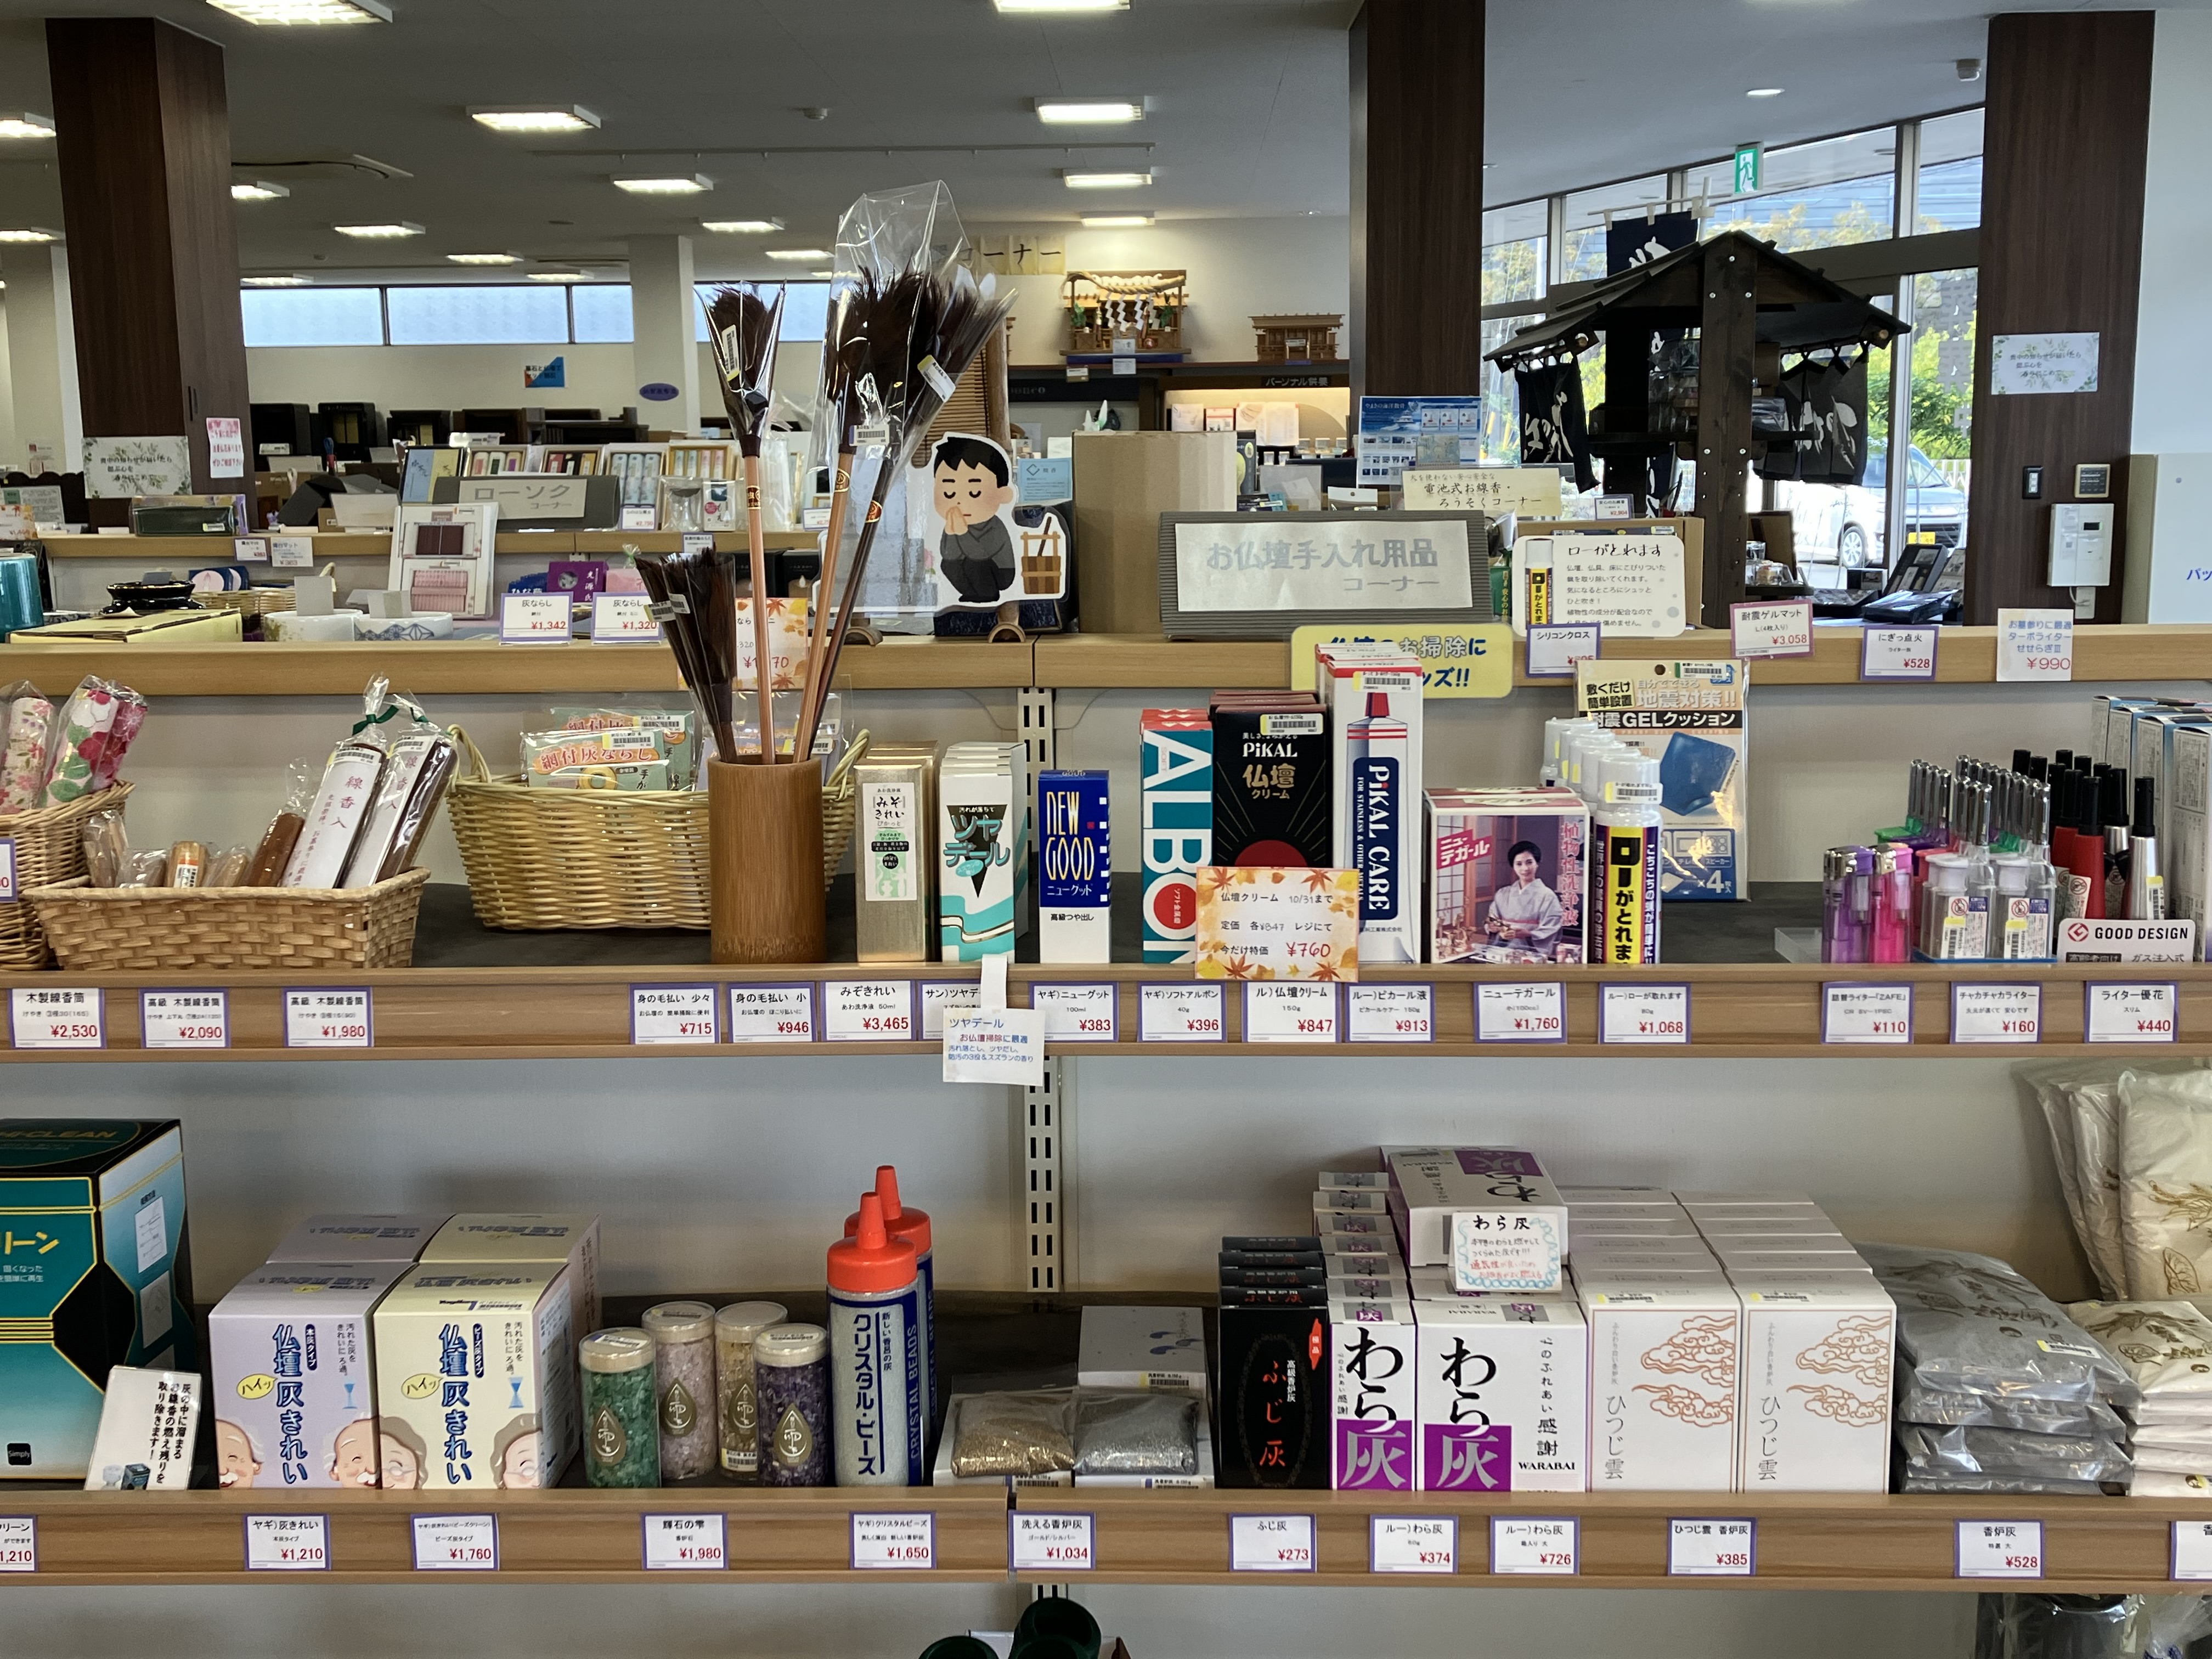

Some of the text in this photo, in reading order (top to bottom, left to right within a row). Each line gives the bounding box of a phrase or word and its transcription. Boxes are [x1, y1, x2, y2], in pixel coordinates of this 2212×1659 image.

[475, 485, 571, 500] ローソク
[531, 501, 572, 510] コーナー
[1440, 497, 1542, 508] ろうそくコーナー
[1206, 538, 1438, 571] お仏壇手入れ用品
[1568, 544, 1662, 556] ローがとれます
[1343, 576, 1440, 591] コーナー
[1742, 610, 1802, 620] 耐震ゲルマット
[532, 622, 566, 631] ¥1,342
[623, 622, 657, 631] ¥1,320
[2008, 620, 2072, 630] お墓参りに最適
[1537, 631, 1590, 640] シリコンクロス
[1773, 635, 1807, 645] ¥3,058
[1878, 633, 1922, 642] にぎっ点火
[1904, 659, 1930, 668] ¥528
[2027, 657, 2071, 669] ¥990
[1587, 682, 1630, 696] 敷くだけ
[1588, 695, 1633, 709] 簡単設置
[1243, 742, 1297, 757] PiKAL
[1242, 763, 1296, 789] 仏壇
[1251, 789, 1290, 799] クリーム
[331, 776, 363, 829] 線香入
[876, 796, 902, 808] みぞ
[875, 809, 905, 820] きれい
[1047, 791, 1080, 836] NEW
[943, 840, 1011, 868] デール
[1046, 837, 1094, 881] GOOD
[1368, 846, 1390, 911] CARE
[1221, 892, 1333, 904] 仏壇クリーム 10/31まで
[1221, 921, 1240, 931] 定価
[1295, 922, 1333, 932] レジにて
[2095, 927, 2188, 939] GOOD DESIGN
[1220, 942, 1331, 957] 今だけ特価 ¥760
[840, 986, 896, 996] みぞきれい
[1256, 986, 1327, 998] ル)仏壇クリーム
[1483, 988, 1556, 998] ニューテガール
[1959, 992, 2037, 1000] チャカチャカライター
[2101, 990, 2164, 1000] ライター優花
[26, 992, 84, 1003] 木製線香筒
[147, 998, 220, 1007] 高級 木製線香筒
[291, 996, 363, 1006] 高級 木製線香筒
[637, 994, 710, 1003] 身の毛払い 少々
[736, 992, 807, 1003] 身の毛払い 小
[680, 1023, 712, 1035] ¥715
[778, 1022, 809, 1033] ¥946
[862, 1018, 909, 1032] ¥3,465
[950, 1018, 1004, 1028] ツヤデール
[1080, 1019, 1111, 1031] ¥383
[1188, 1019, 1219, 1031] ¥396
[1298, 1020, 1333, 1032] ¥847
[1396, 1020, 1428, 1032] ¥913
[1514, 1018, 1559, 1031] ¥1,760
[1640, 1022, 1684, 1035] ¥1,068
[1873, 1022, 1905, 1033] ¥110
[2002, 1021, 2036, 1032] ¥160
[2137, 1019, 2171, 1032] ¥440
[50, 1025, 97, 1039] ¥2,530
[179, 1027, 222, 1040] ¥2,090
[322, 1026, 365, 1039] ¥1,980
[960, 1034, 1028, 1044] お仏壇掃除に最適
[1473, 1215, 1530, 1231] わら灰
[853, 1313, 876, 1476] クリスタル・ビーズ
[907, 1323, 920, 1459] CRYSTAL BEADS
[272, 1324, 308, 1484] 仏壇灰きれい
[439, 1323, 472, 1484] 仏壇灰きれい
[1342, 1328, 1408, 1488] わら灰
[1260, 1360, 1287, 1467] ふじ灰
[1436, 1337, 1499, 1489] わら灰
[1604, 1395, 1626, 1481] ひつじ雲
[1758, 1395, 1781, 1482] ひつじ雲
[8, 1450, 30, 1458] Simply
[1519, 1462, 1575, 1470] WARABAI
[252, 1521, 319, 1530] ヤギ)灰きれい
[663, 1520, 704, 1530] 輝石の雫
[1022, 1519, 1083, 1530] 洗える香炉灰
[1257, 1521, 1287, 1531] ふじ灰
[1386, 1524, 1442, 1534] ルー)わら灰
[1506, 1525, 1563, 1535] ルー)わら灰
[1675, 1525, 1748, 1534] ひつじ雲 香炉灰
[1984, 1527, 2016, 1537] 香炉灰
[281, 1548, 323, 1561] ¥1,210
[450, 1548, 491, 1561] ¥1,760
[679, 1548, 721, 1560] ¥1,980
[887, 1547, 929, 1560] ¥1,650
[1047, 1547, 1087, 1560] ¥1,034
[1278, 1549, 1309, 1560] ¥273
[1419, 1552, 1451, 1564] ¥374
[1540, 1554, 1571, 1565] ¥726
[1717, 1554, 1747, 1565] ¥385
[2006, 1556, 2038, 1568] ¥528
